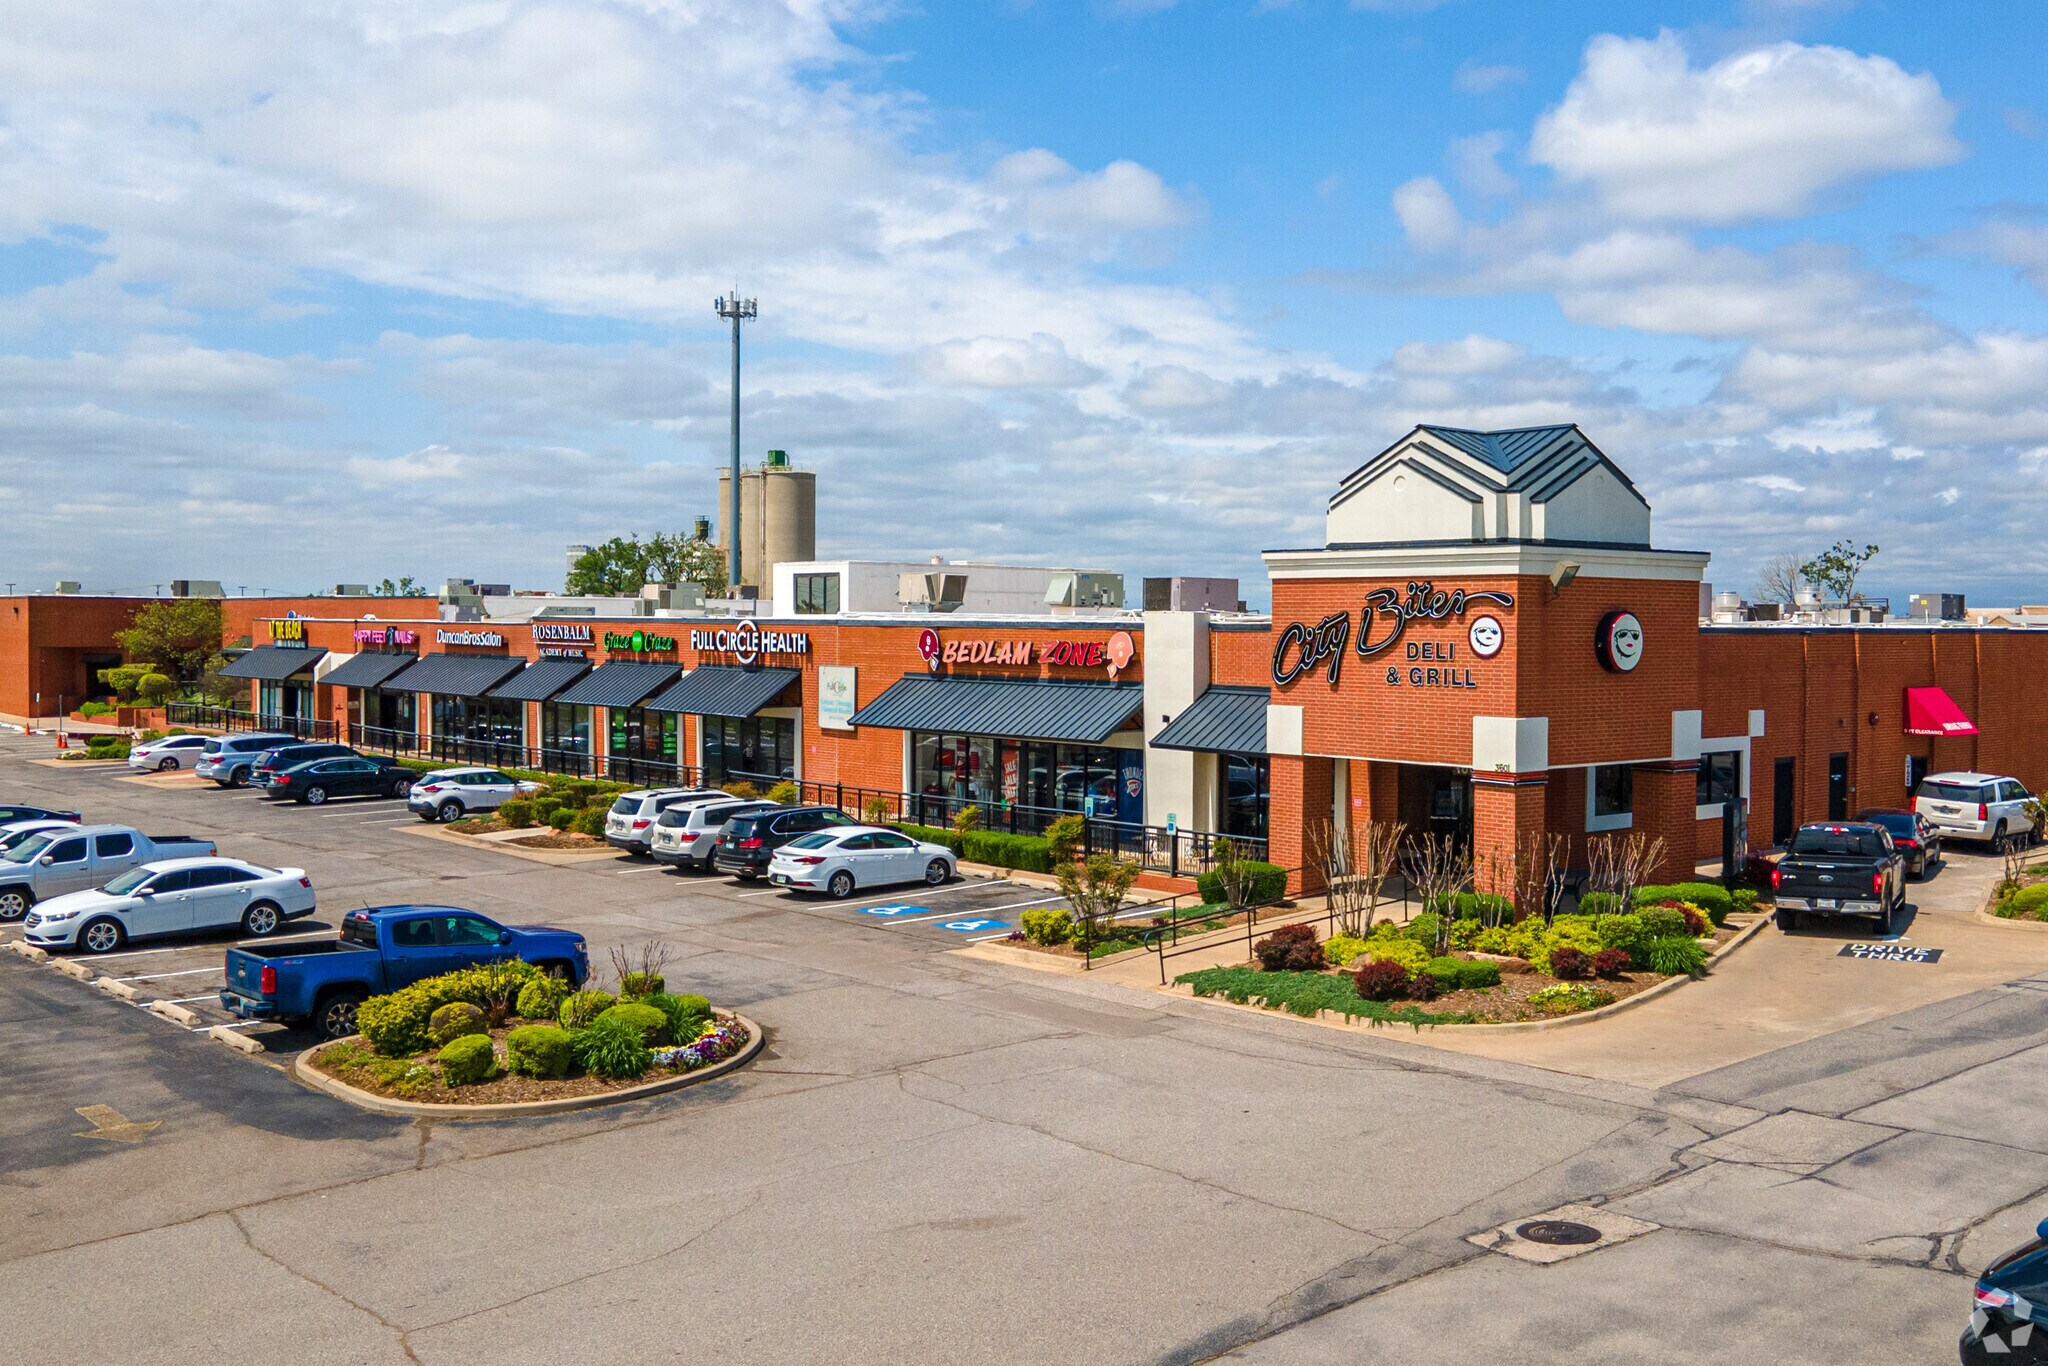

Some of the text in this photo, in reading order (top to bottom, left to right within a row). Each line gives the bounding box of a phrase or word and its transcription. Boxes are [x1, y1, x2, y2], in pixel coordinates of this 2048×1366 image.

[353, 629, 371, 643] HAPPY
[371, 630, 386, 643] FEET
[436, 628, 502, 647] DuncanBrosSalon
[532, 624, 590, 640] ROSENBALM
[690, 629, 806, 653] FULL CIRCLE HEALTH
[1271, 581, 1514, 686] City Bites
[603, 631, 630, 653] Graze
[645, 631, 673, 652] Craze
[1406, 642, 1454, 661] DELI
[941, 639, 1104, 667] BEDLAM ZONE
[1386, 666, 1477, 687] & GRILL
[1122, 766, 1143, 780] THUNDE
[1851, 944, 1932, 962] DRIVE THRU
